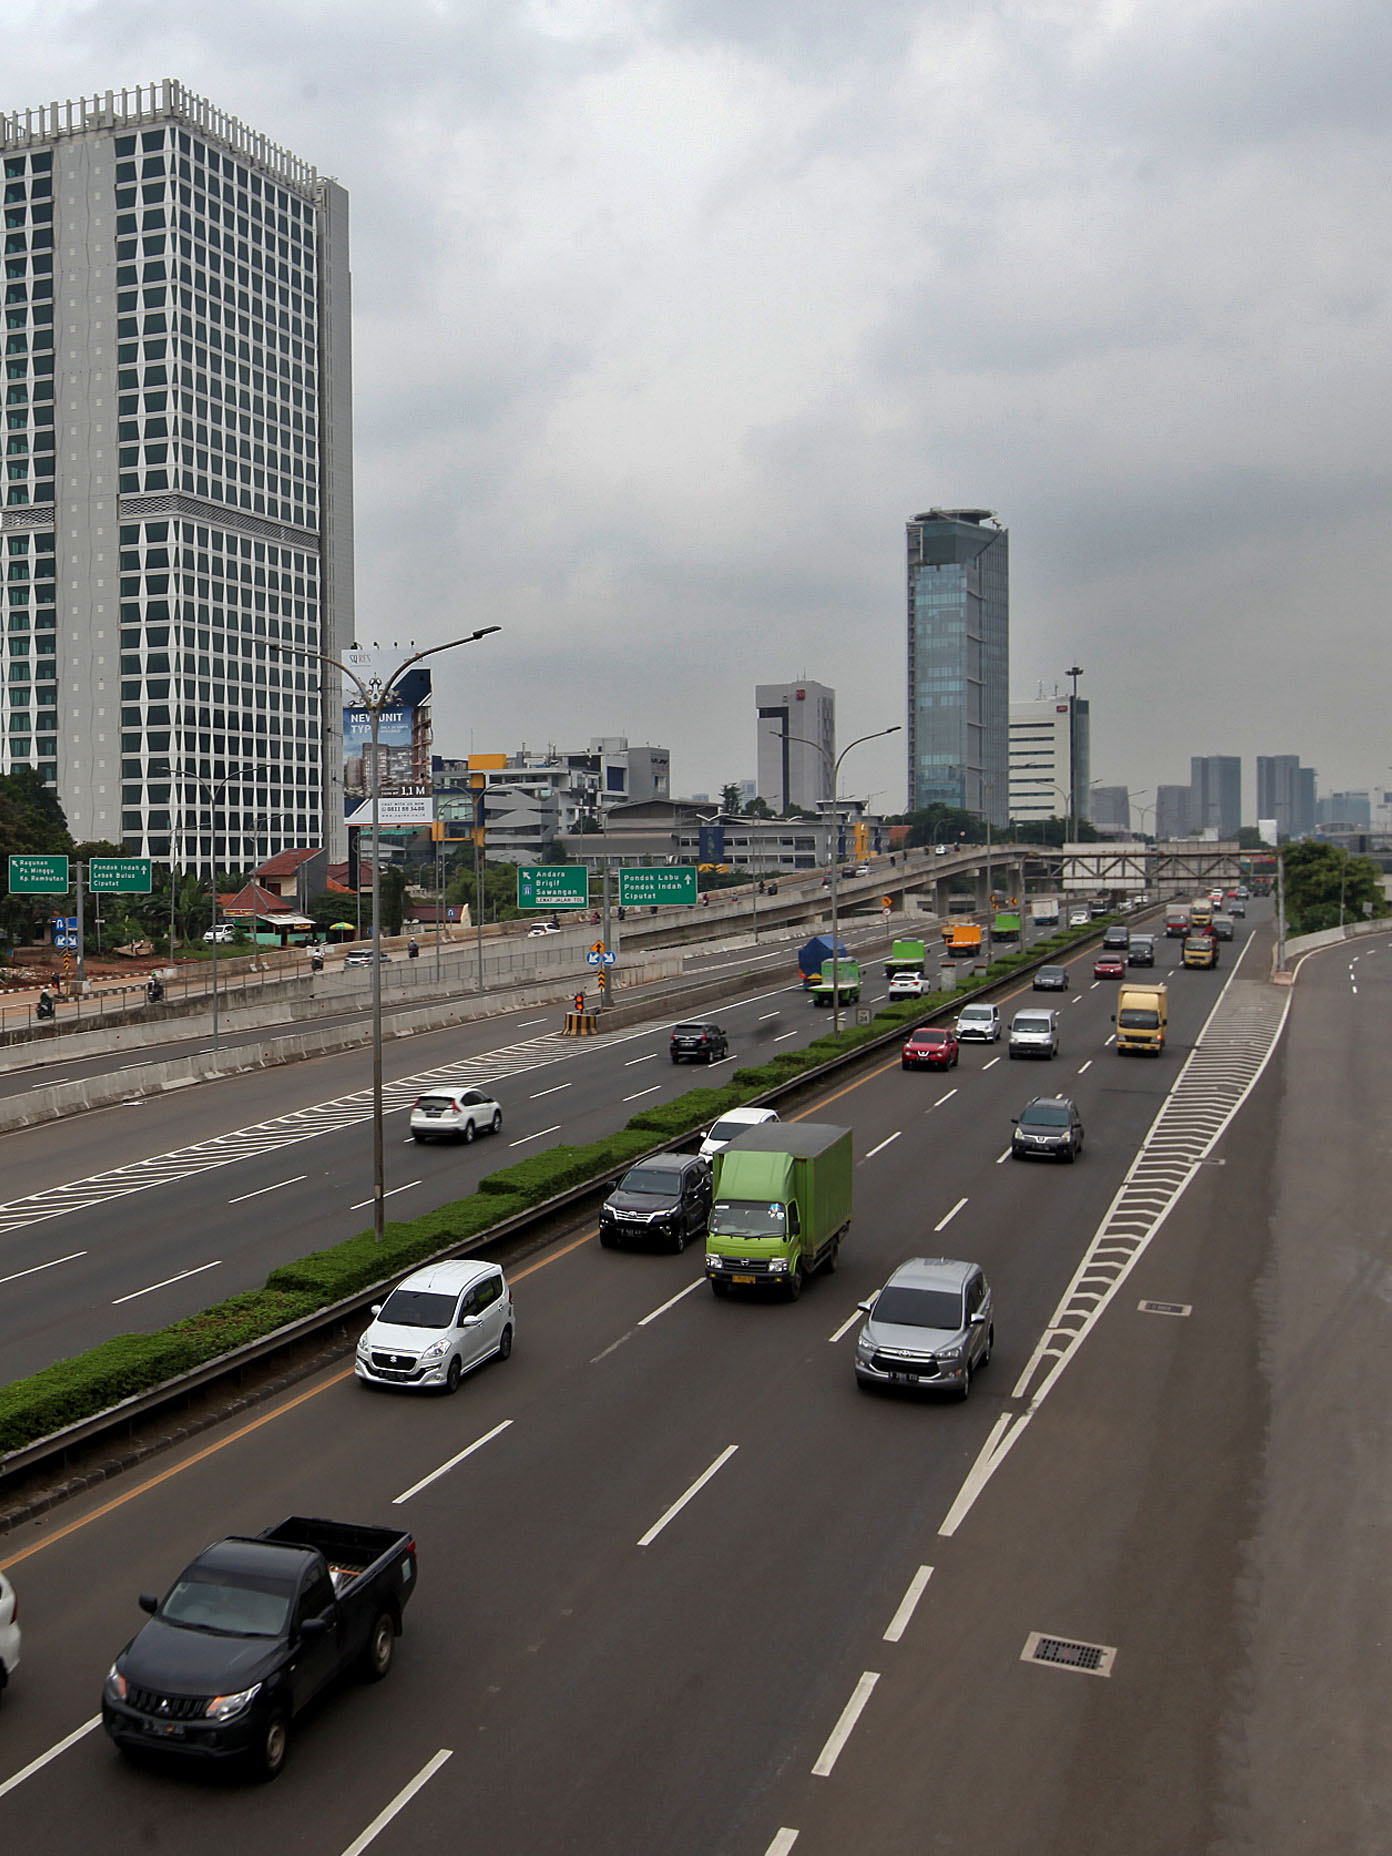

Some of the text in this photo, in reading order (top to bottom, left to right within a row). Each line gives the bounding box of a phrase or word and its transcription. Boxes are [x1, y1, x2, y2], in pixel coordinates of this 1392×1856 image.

[378, 713, 403, 722] UNIT
[415, 786, 426, 795] M
[536, 880, 560, 888] Brigif
[624, 892, 656, 900] Ciputat
